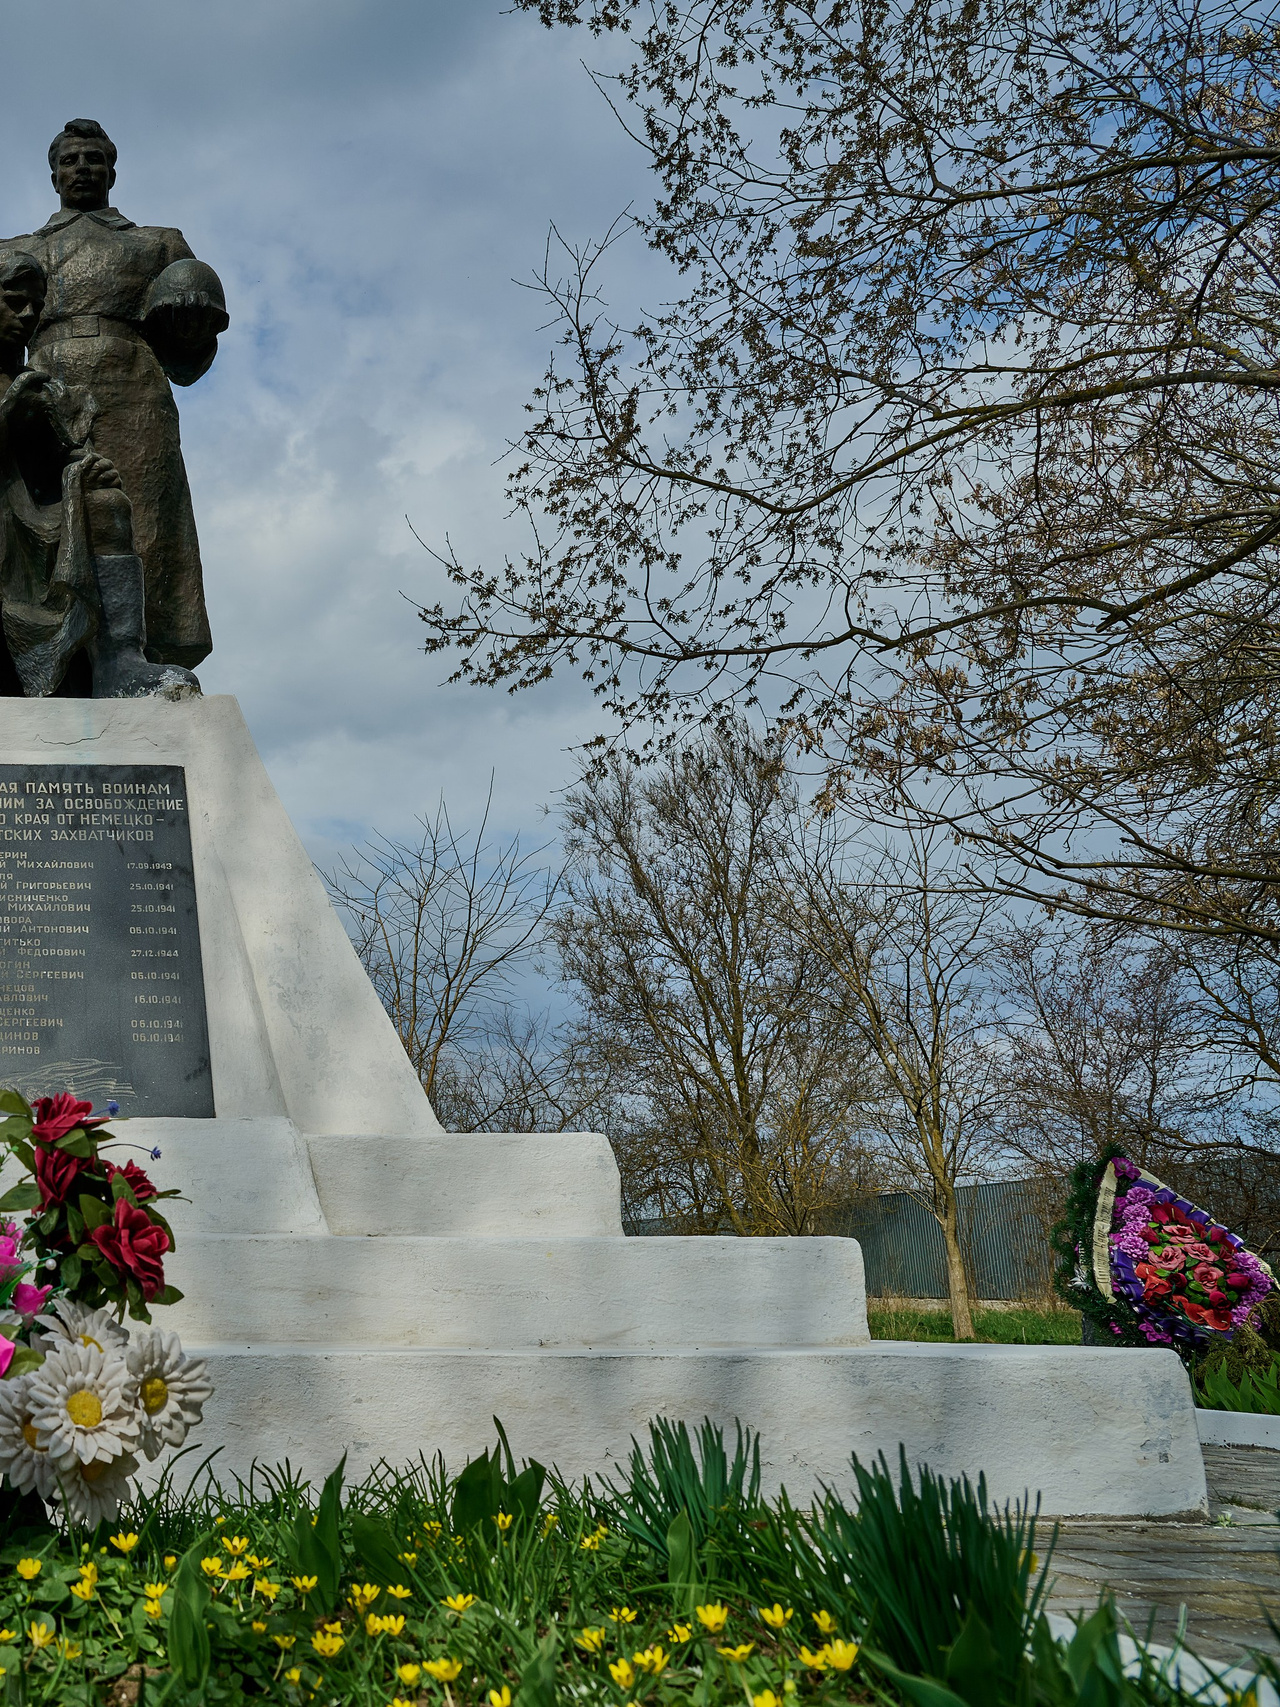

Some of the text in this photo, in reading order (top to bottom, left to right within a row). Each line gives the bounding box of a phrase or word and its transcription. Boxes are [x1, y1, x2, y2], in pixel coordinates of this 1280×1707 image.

[26, 782, 94, 794] ПАМЯТЬ
[102, 783, 170, 795] ВОИНАМ
[36, 798, 54, 809] ЗА
[64, 798, 184, 812] ОСВОБОЖДЕНИЕ
[15, 814, 49, 825] КРАЯ
[57, 814, 74, 825] ОТ
[80, 814, 165, 827] НЕМЕЦКО-
[50, 829, 154, 842] ЗАХВАТЧИКОВ
[17, 860, 94, 869] МИХАЙЛОВИЧ
[16, 881, 92, 890] ГРИГОРЬЕВИЧ
[8, 902, 91, 912] МИХАЙЛОВИЧ
[21, 924, 89, 934] АНТОНОВИЧ
[18, 947, 86, 957] ФЕДОРОВИЧ
[17, 970, 84, 979] СЕРГЕЕВИЧ
